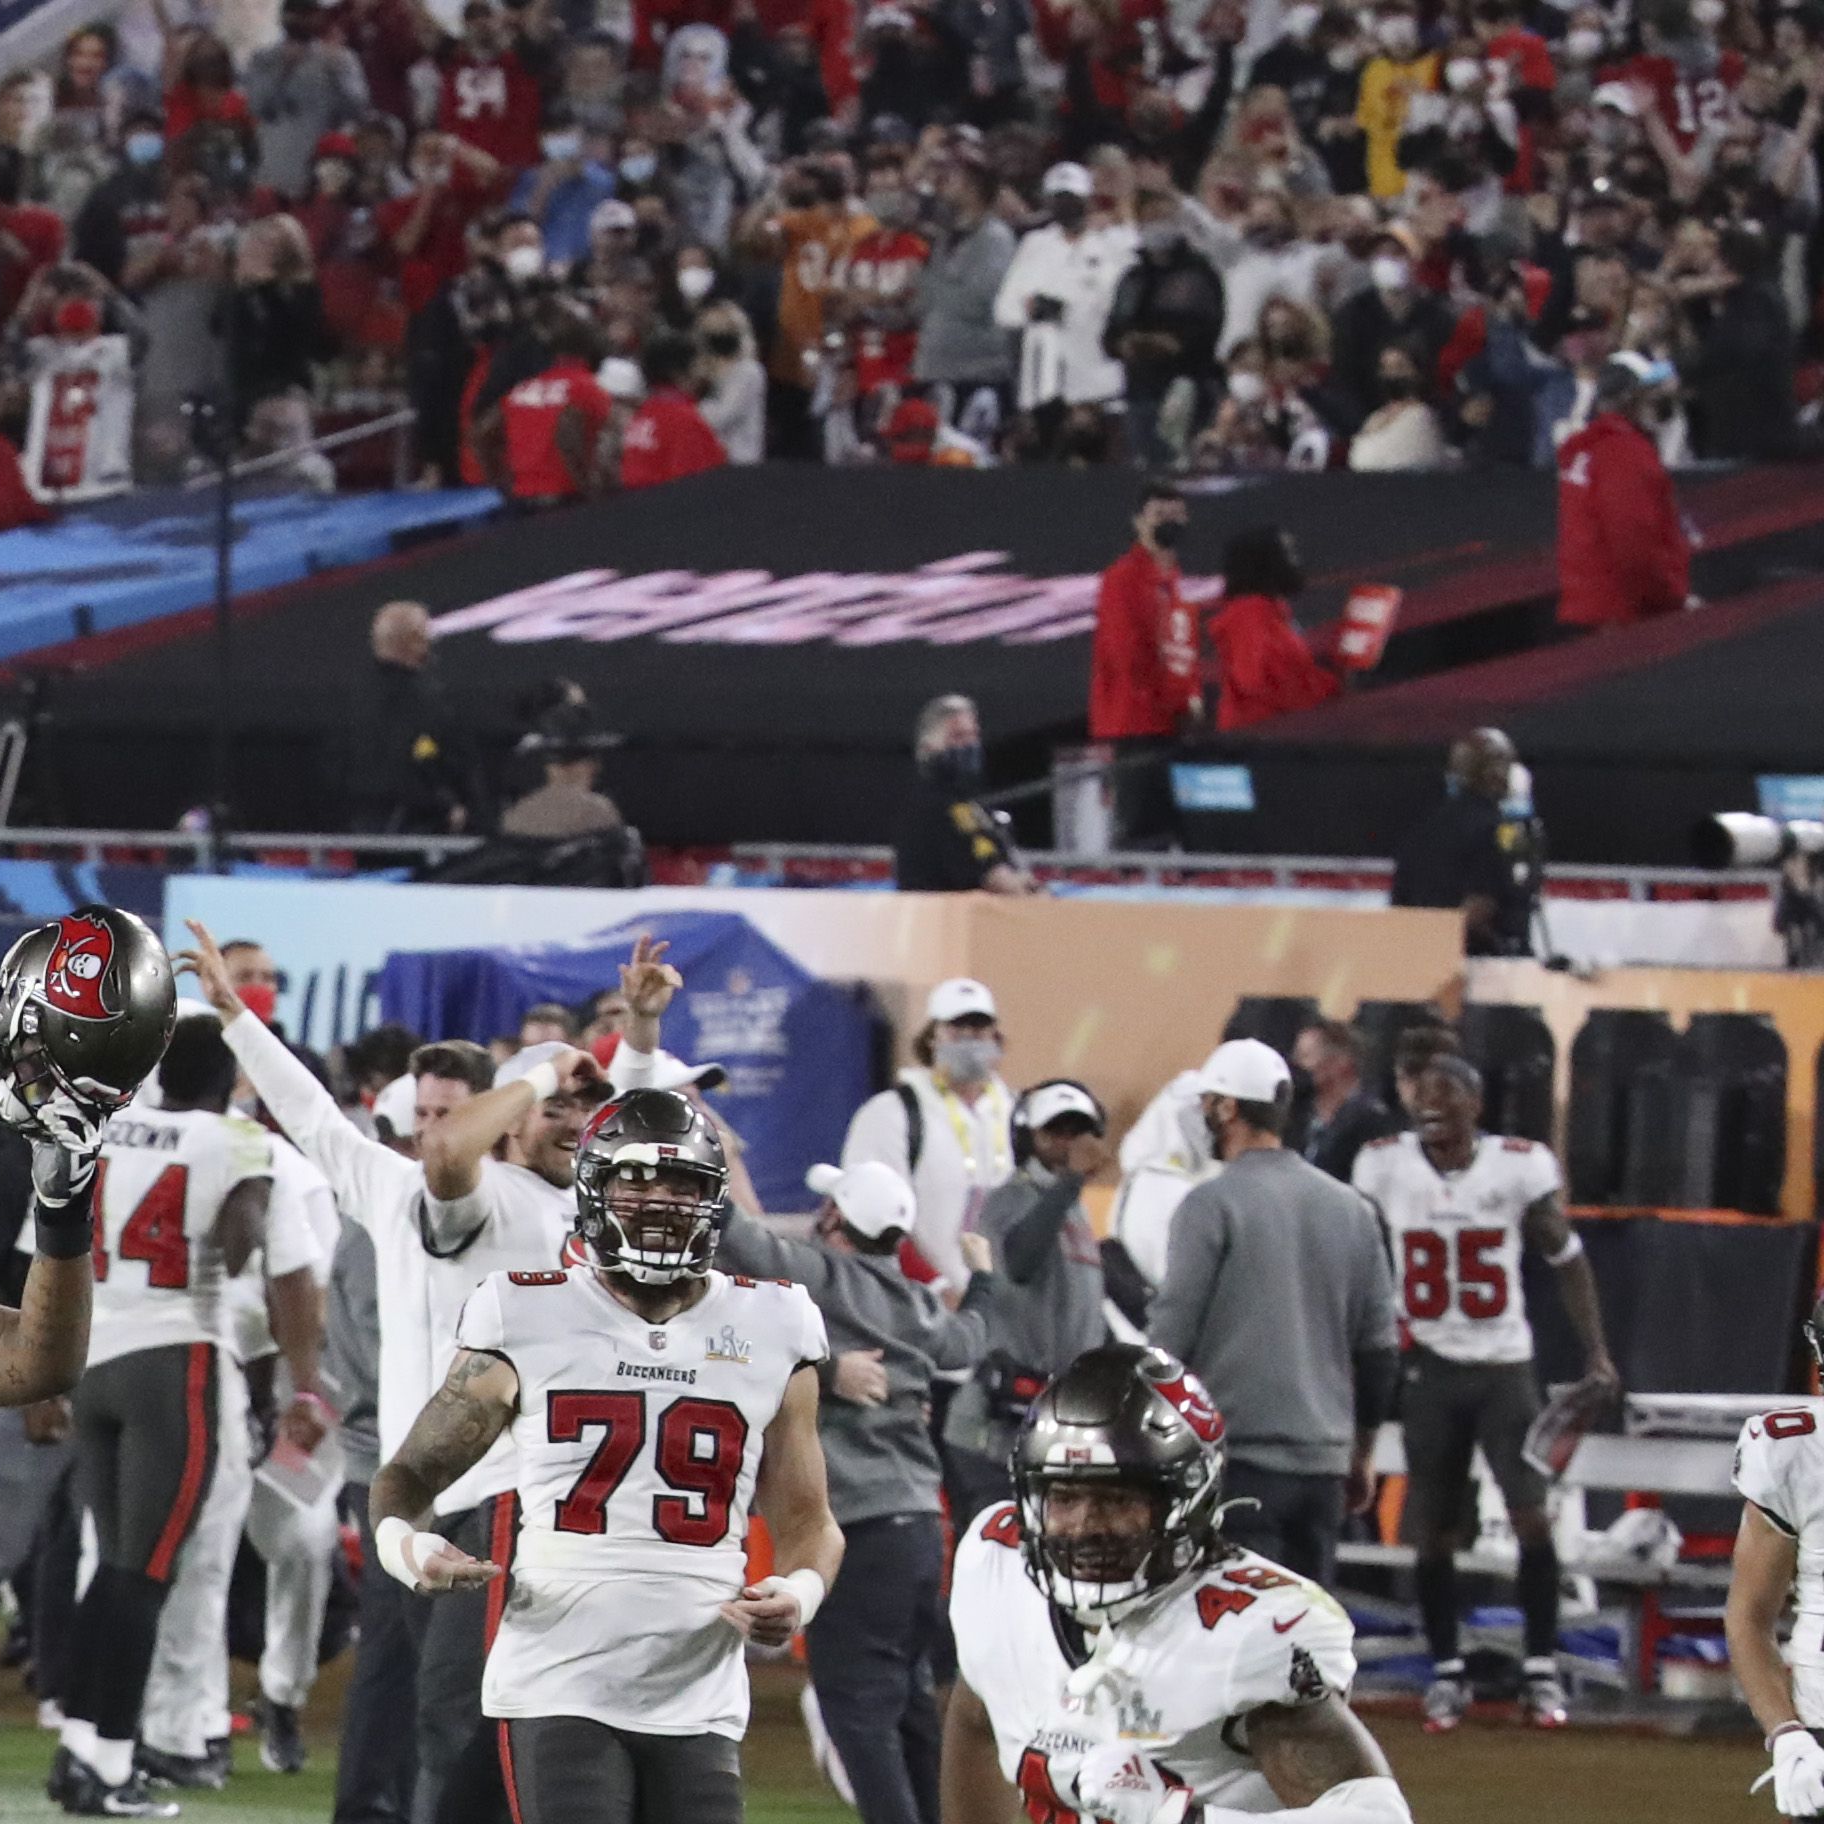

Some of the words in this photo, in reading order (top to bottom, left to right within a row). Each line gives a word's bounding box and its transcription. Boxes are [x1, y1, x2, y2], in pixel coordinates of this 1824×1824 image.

[1402, 1228, 1509, 1320] 85
[616, 1360, 697, 1386] BUCCANEERS
[546, 1388, 750, 1547] 79
